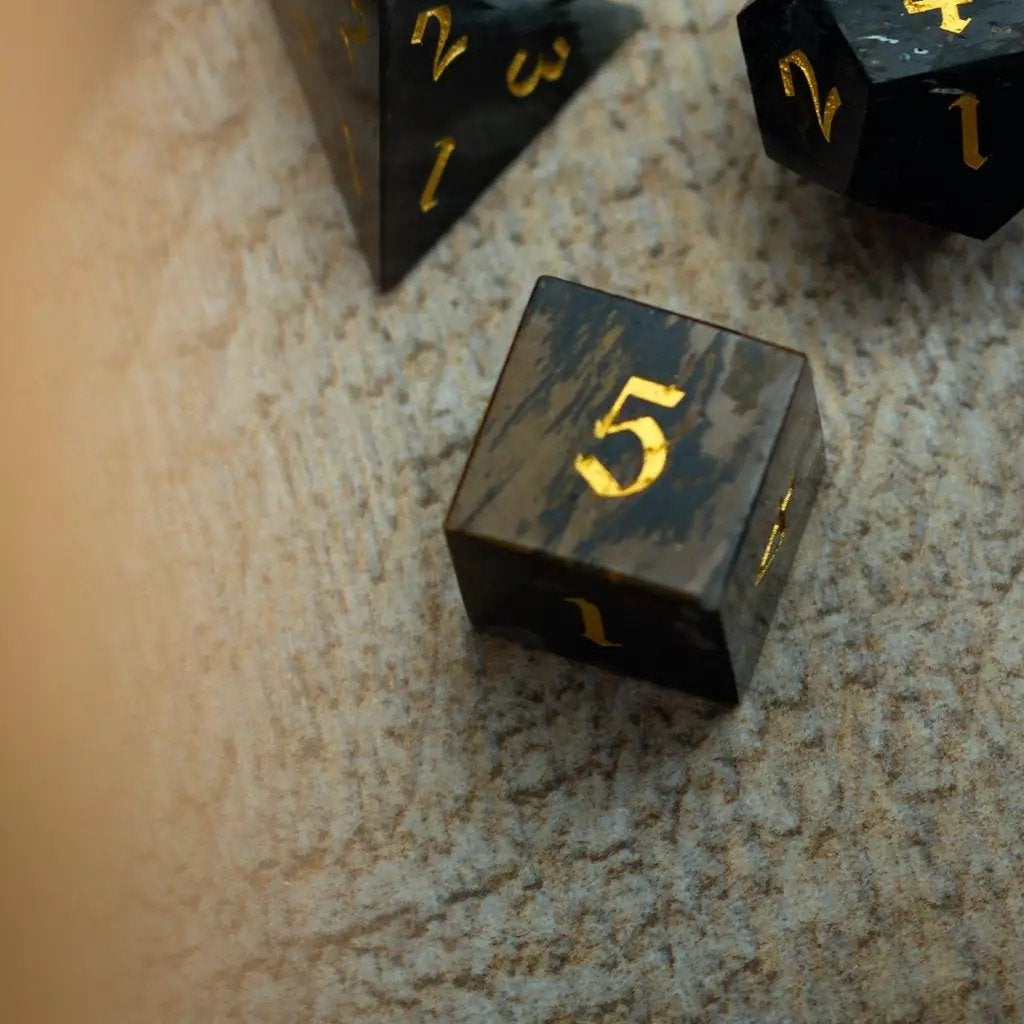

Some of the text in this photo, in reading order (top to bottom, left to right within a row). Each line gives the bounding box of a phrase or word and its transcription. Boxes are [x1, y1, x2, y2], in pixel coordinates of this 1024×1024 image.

[409, 4, 469, 82] 2
[505, 36, 571, 98] 3
[778, 48, 843, 144] 2
[948, 92, 992, 171] 1
[420, 135, 456, 213] 1
[574, 375, 686, 499] 5
[564, 595, 625, 648] 1
